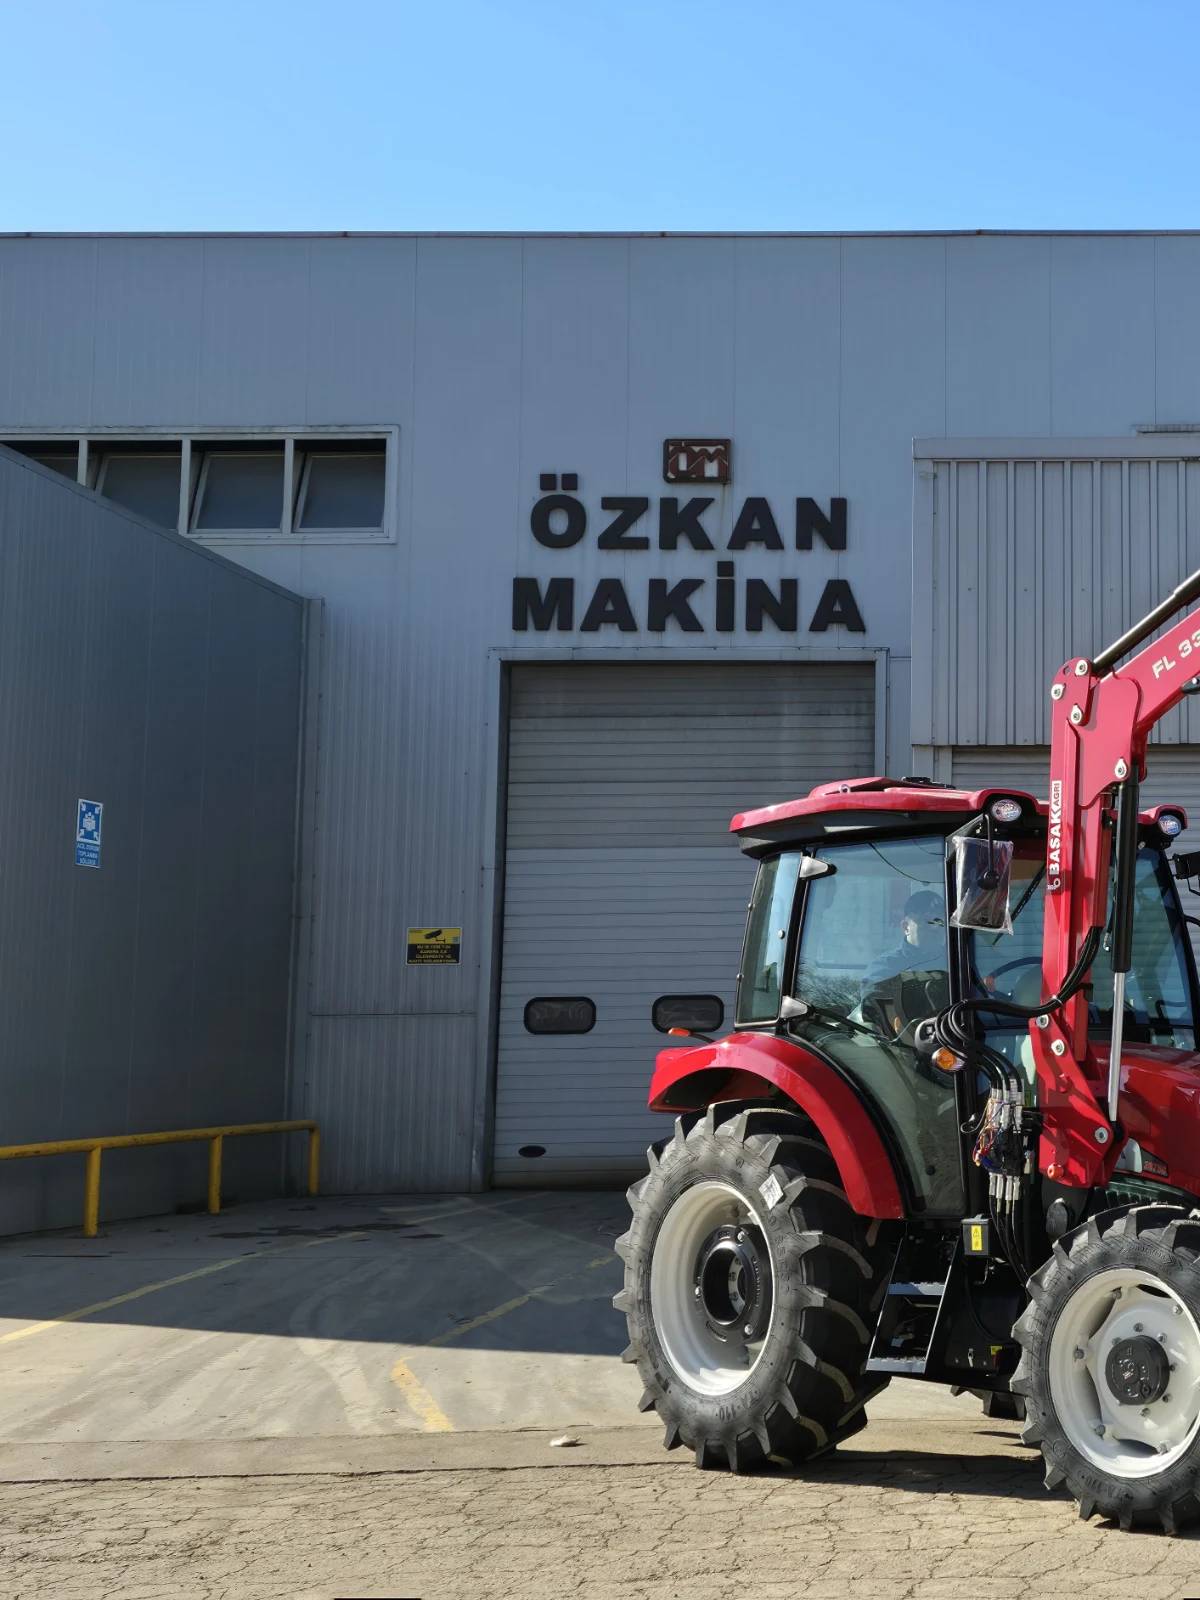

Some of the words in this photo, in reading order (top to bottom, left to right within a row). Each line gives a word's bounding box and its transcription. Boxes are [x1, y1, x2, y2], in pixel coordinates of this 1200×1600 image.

[530, 472, 848, 550] ÖZKAN
[511, 560, 866, 633] MAKİNA
[1151, 655, 1177, 680] FL
[1053, 782, 1061, 808] AGRI
[1049, 807, 1062, 875] BASAK
